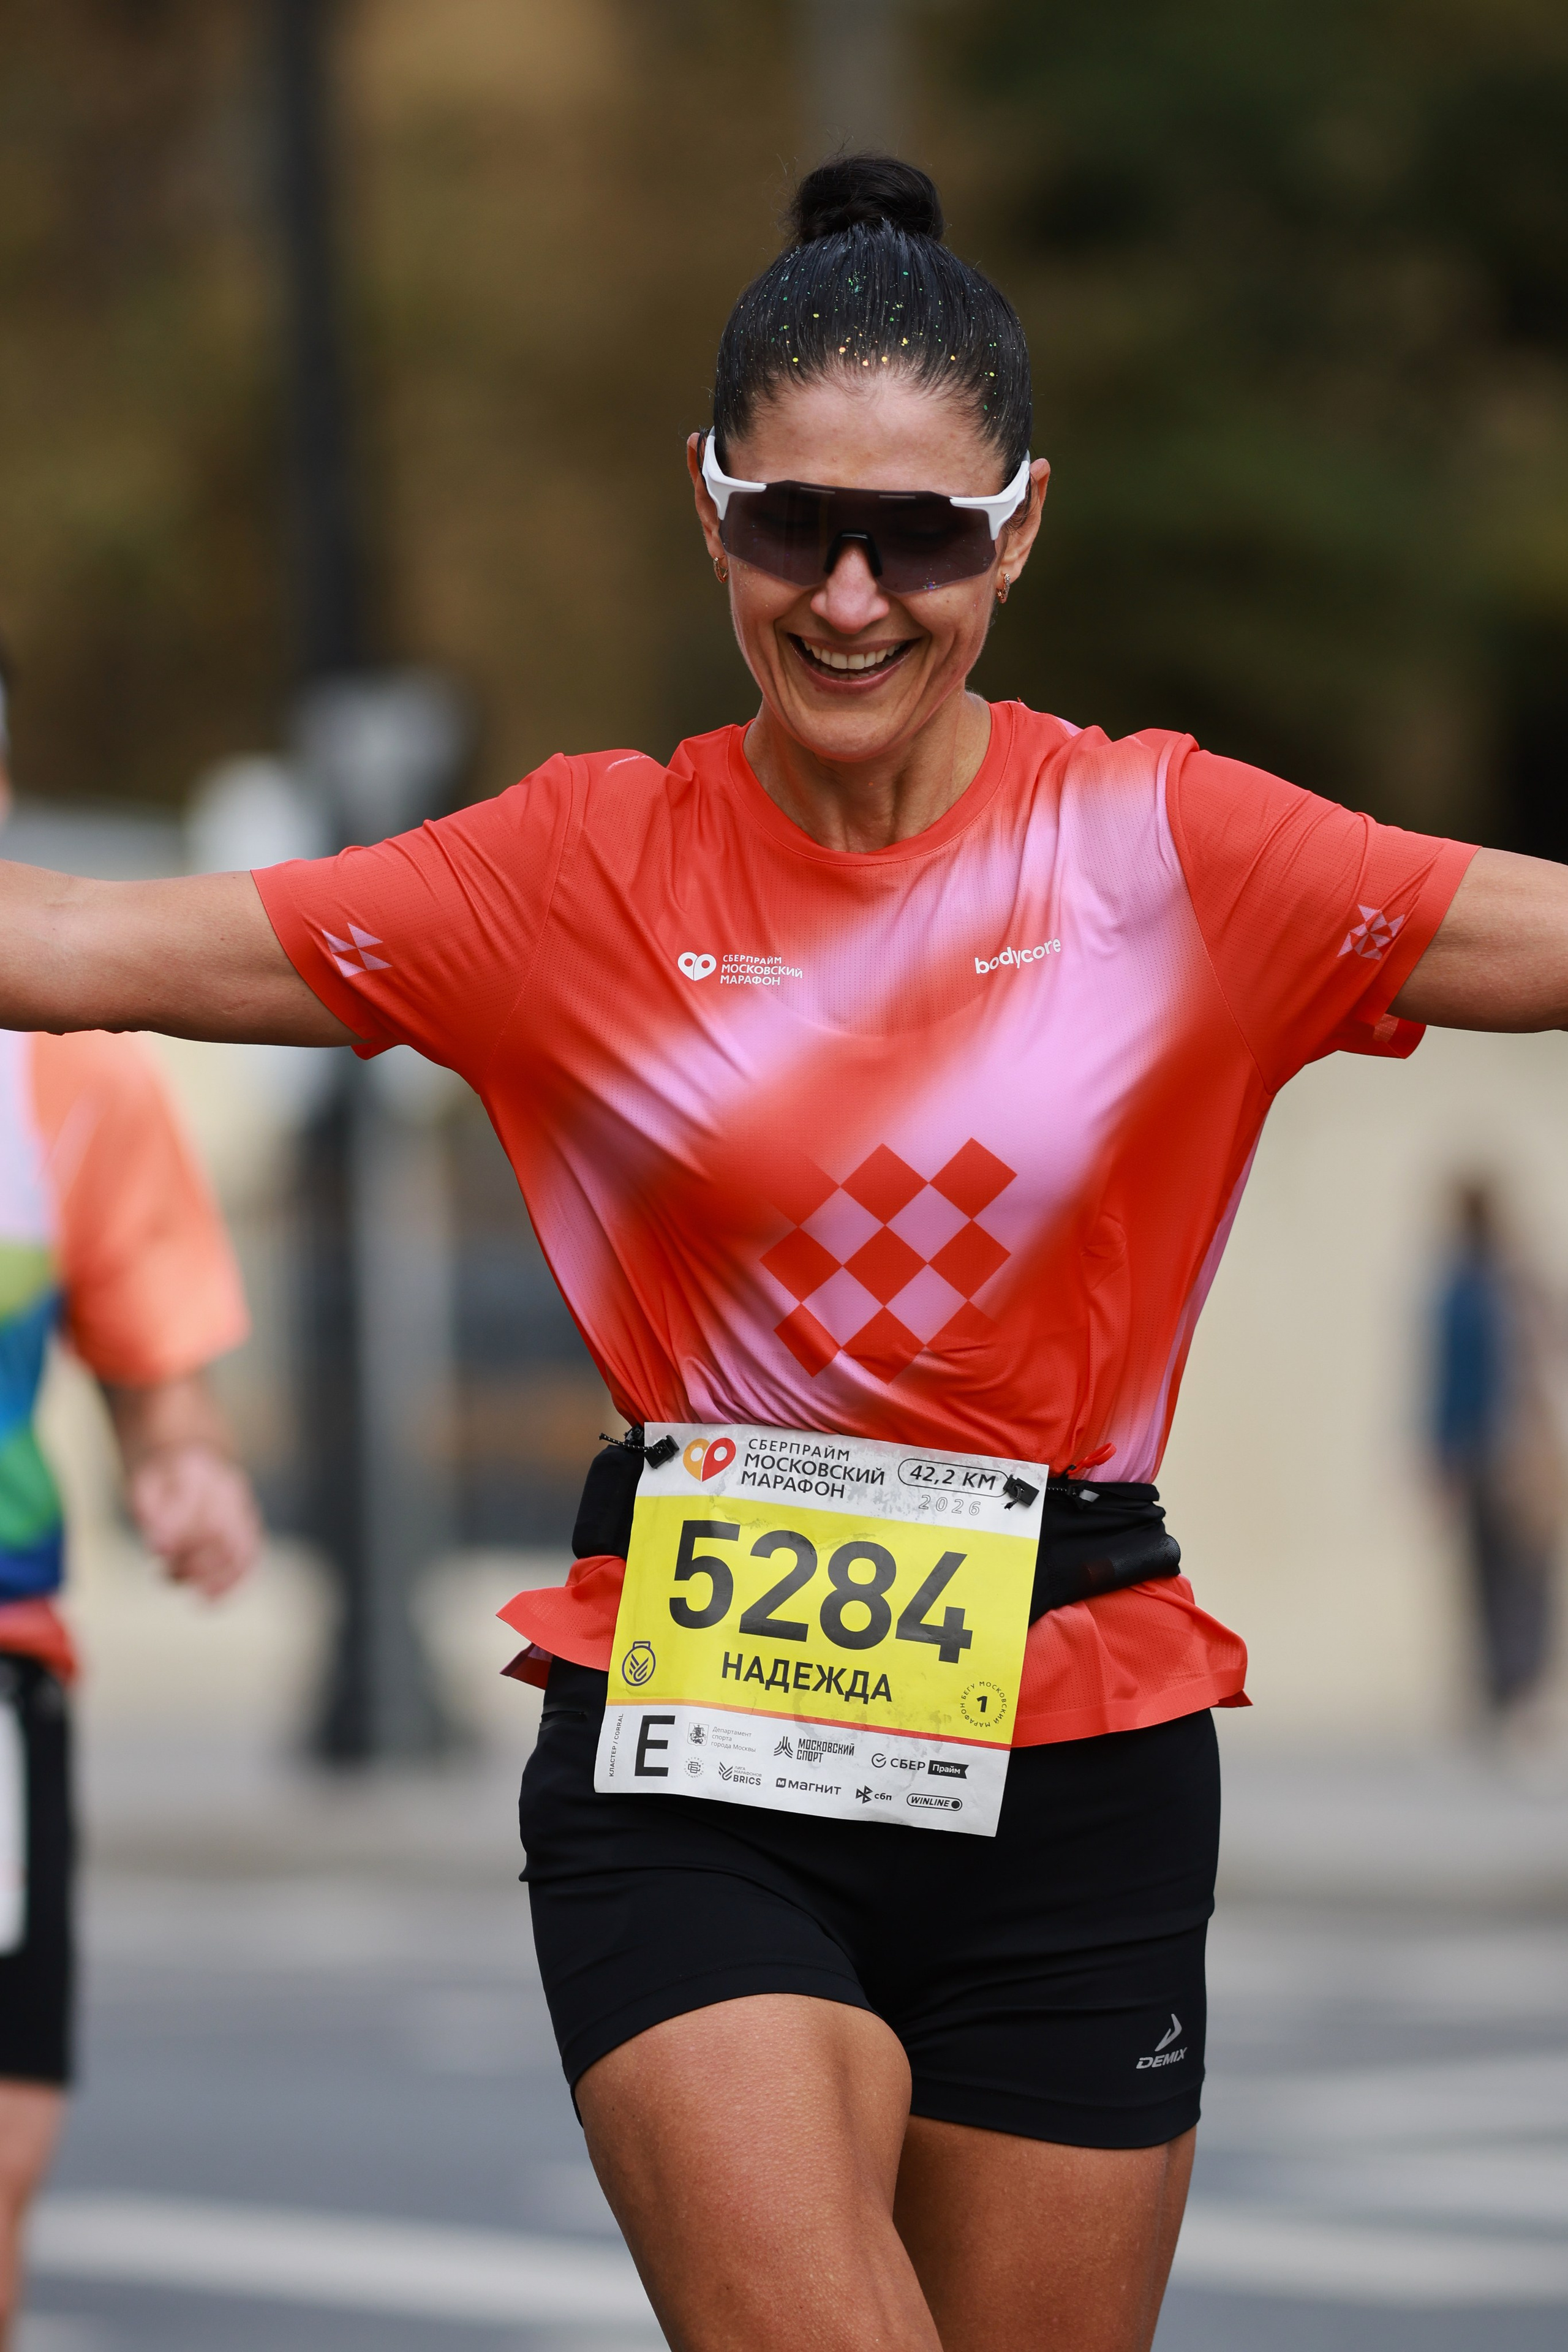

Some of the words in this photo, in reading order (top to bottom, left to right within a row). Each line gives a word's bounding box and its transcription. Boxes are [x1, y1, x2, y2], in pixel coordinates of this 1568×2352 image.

[723, 954, 782, 965] СБЕРПРАЙМ
[974, 938, 1061, 974] bodycore
[720, 975, 780, 986] МАРАФОН
[721, 963, 803, 979] МОСКОВСКИЙ
[748, 1439, 850, 1461] СБЕРПРАЙМ
[744, 1453, 885, 1486] МОСКОВСКИЙ
[910, 1465, 956, 1485] 42,2
[741, 1471, 845, 1499] МАРАФОН
[919, 1494, 981, 1516] 2026
[669, 1520, 973, 1665] 5284
[722, 1651, 892, 1705] НАДЕЖДА
[961, 1683, 975, 1700] БЕГУ
[976, 1695, 988, 1713] 1
[979, 1681, 1008, 1724] МОСКОВСКИЙ
[960, 1703, 991, 1727] МАРАФОН
[614, 1713, 624, 1740] CORRAL
[712, 1726, 752, 1737] Департамент
[733, 1744, 756, 1752] Москвы
[796, 1750, 824, 1763] СПОРТ
[798, 1738, 855, 1756] МОСКОВСКИЙ
[890, 1758, 925, 1771] СБЕР
[932, 1764, 961, 1774] Прайм
[733, 1774, 761, 1785] BRICS
[910, 1796, 951, 1807] WINLINE
[1136, 2047, 1188, 2069] DEMIX
